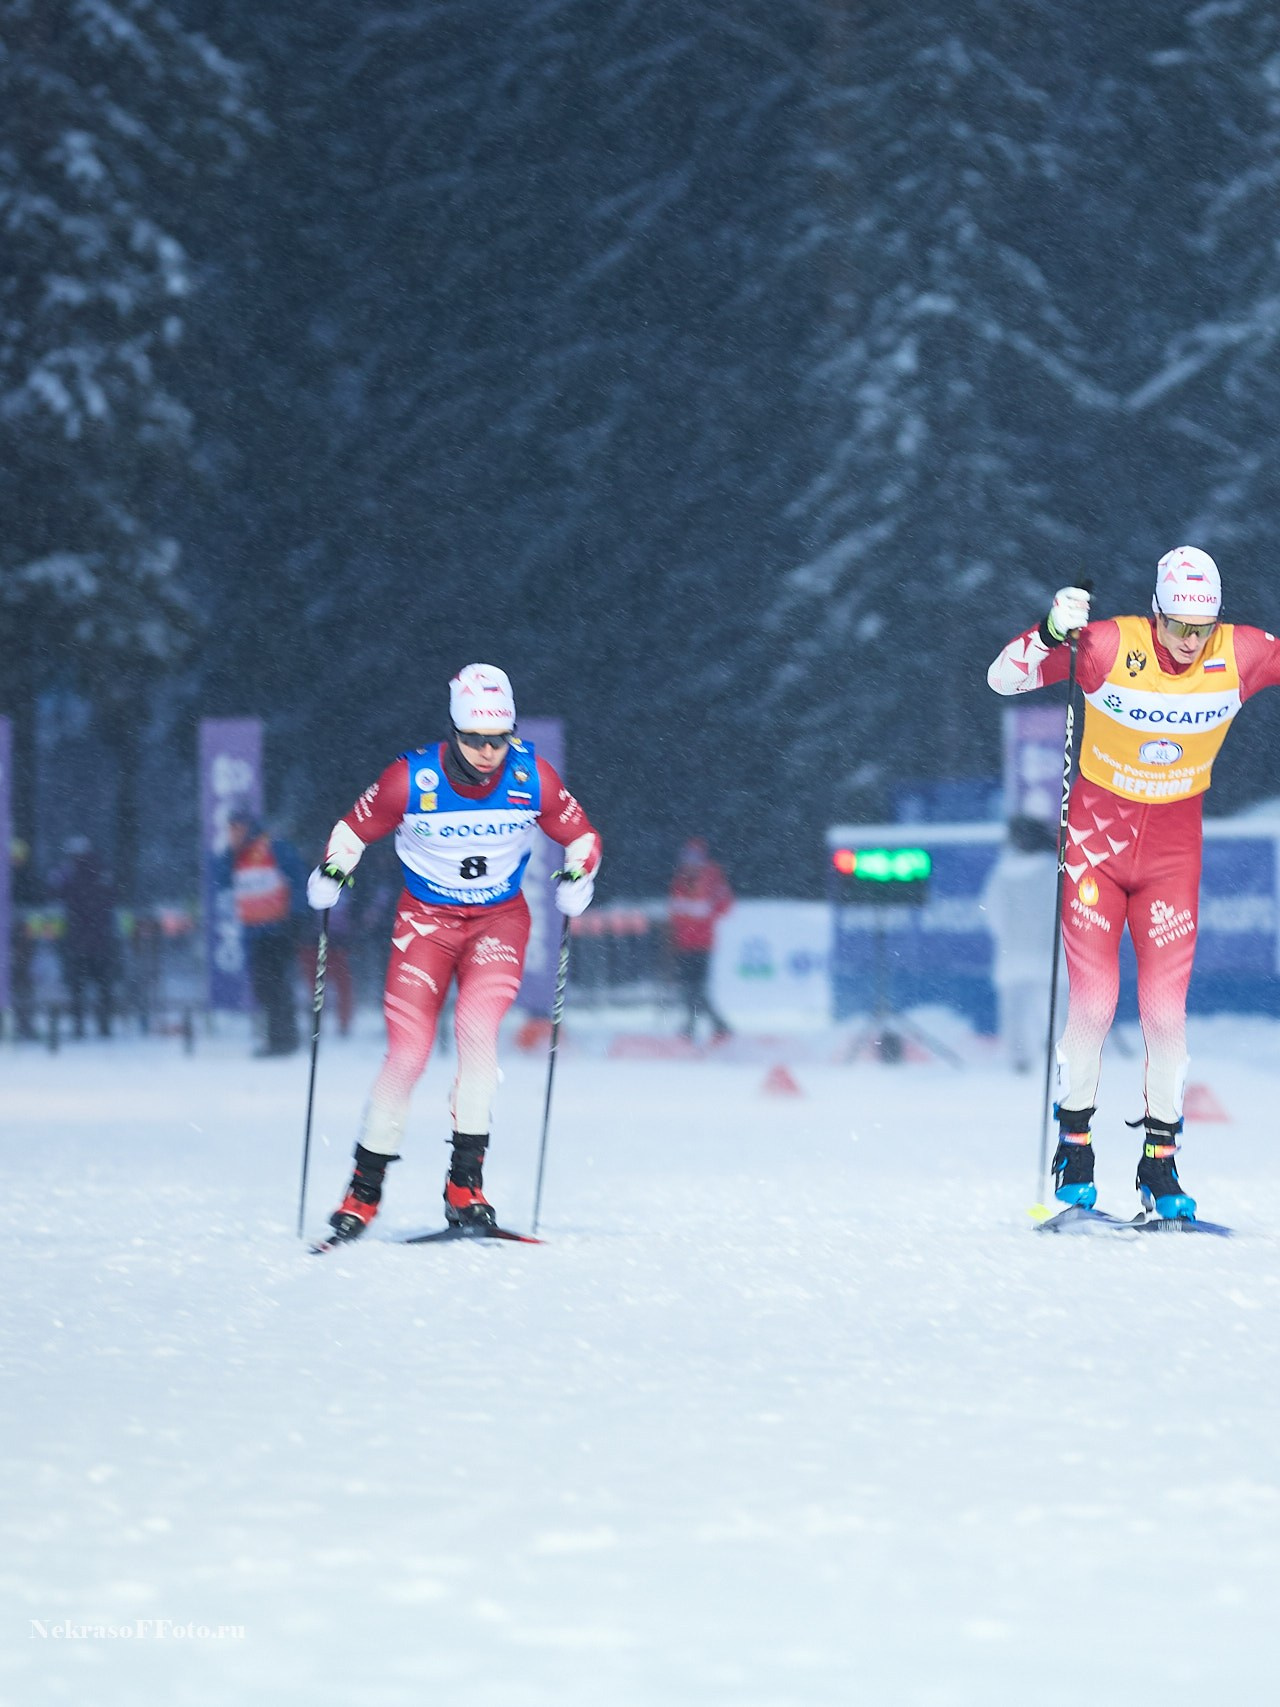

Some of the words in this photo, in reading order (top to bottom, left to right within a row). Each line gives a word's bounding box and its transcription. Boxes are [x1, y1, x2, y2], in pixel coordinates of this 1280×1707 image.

[1172, 592, 1218, 605] ЛУКОЙЛ
[1129, 705, 1230, 725] ФОСАГРО
[1123, 764, 1166, 780] России
[1111, 771, 1194, 798] ПЕРЕКОП
[459, 855, 488, 880] 8
